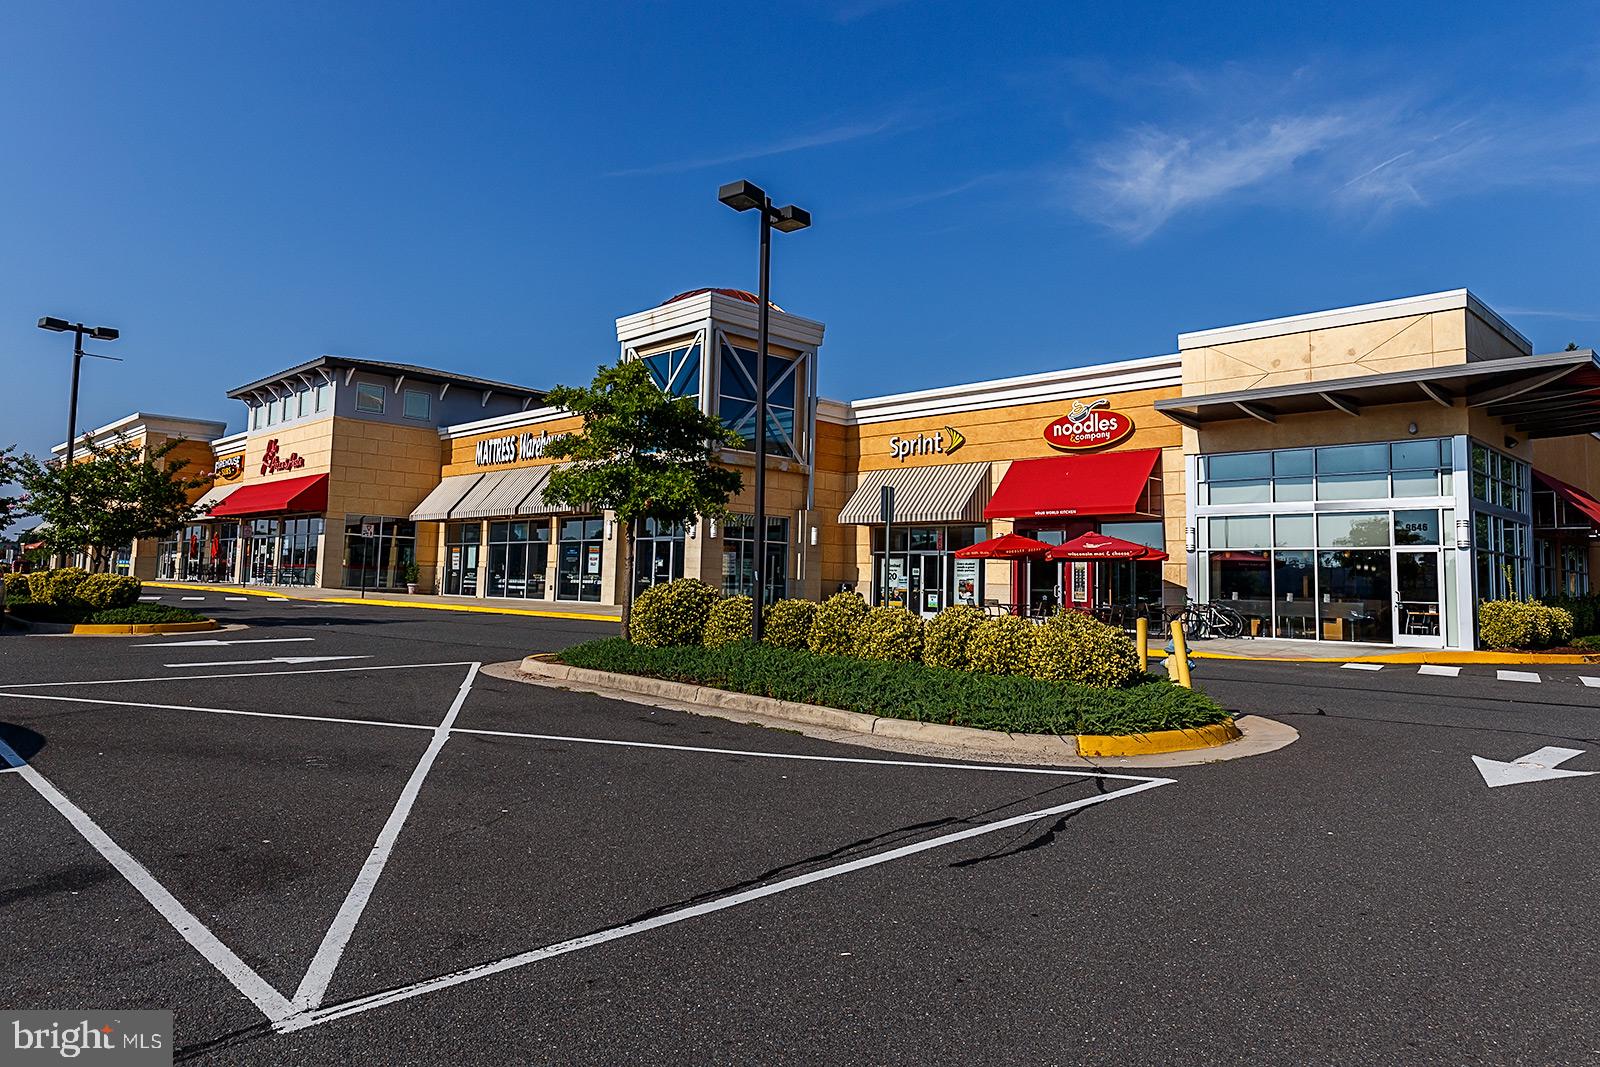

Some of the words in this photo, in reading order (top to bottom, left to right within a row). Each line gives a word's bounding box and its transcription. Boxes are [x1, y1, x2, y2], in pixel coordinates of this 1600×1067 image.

[1053, 412, 1118, 437] noodles
[475, 435, 517, 465] MATTRESS
[889, 431, 942, 462] Sprint
